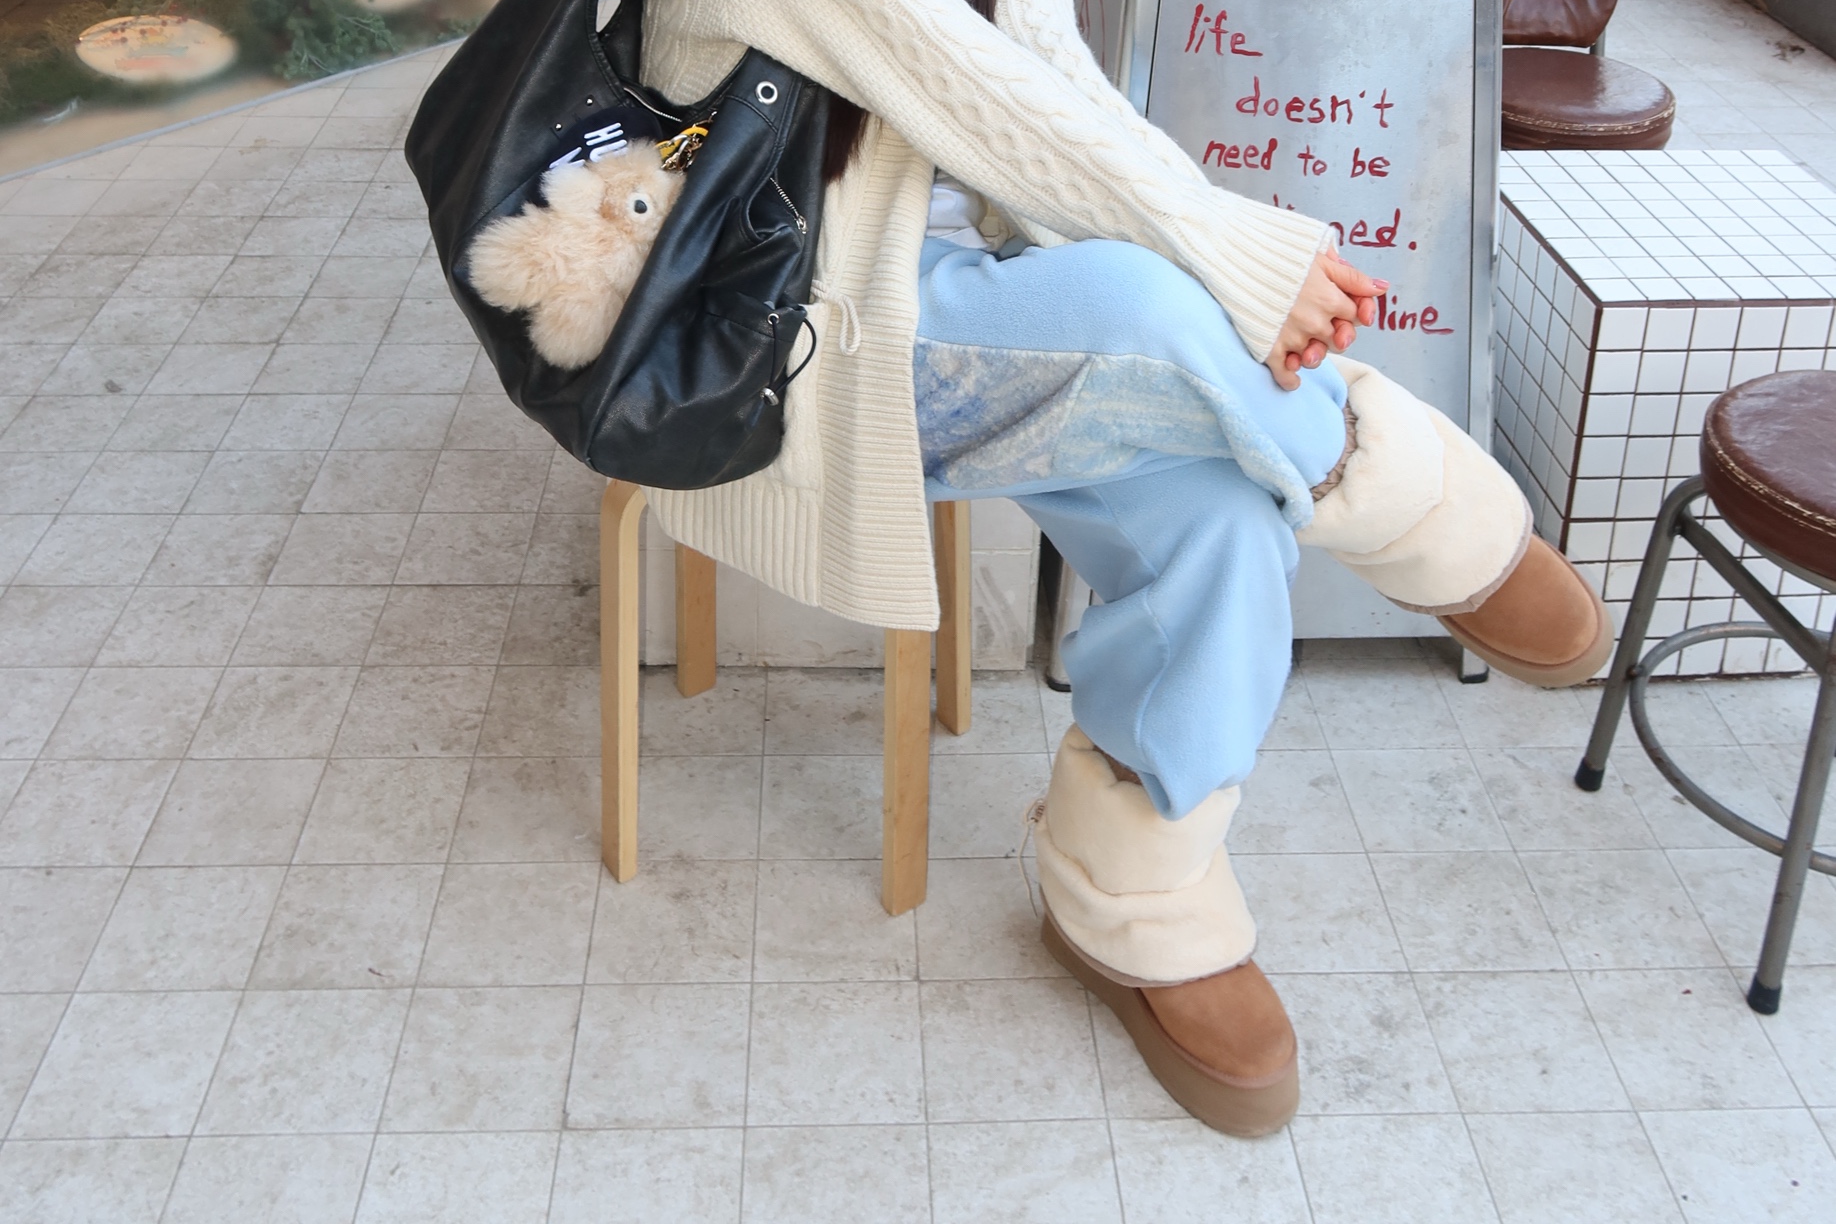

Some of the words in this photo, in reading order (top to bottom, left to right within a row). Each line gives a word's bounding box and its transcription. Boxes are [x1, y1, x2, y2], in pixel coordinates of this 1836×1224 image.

[1185, 3, 1263, 57] life
[1235, 75, 1394, 128] doesn't
[1202, 138, 1278, 171] need
[1297, 144, 1328, 176] to
[1350, 147, 1391, 178] be
